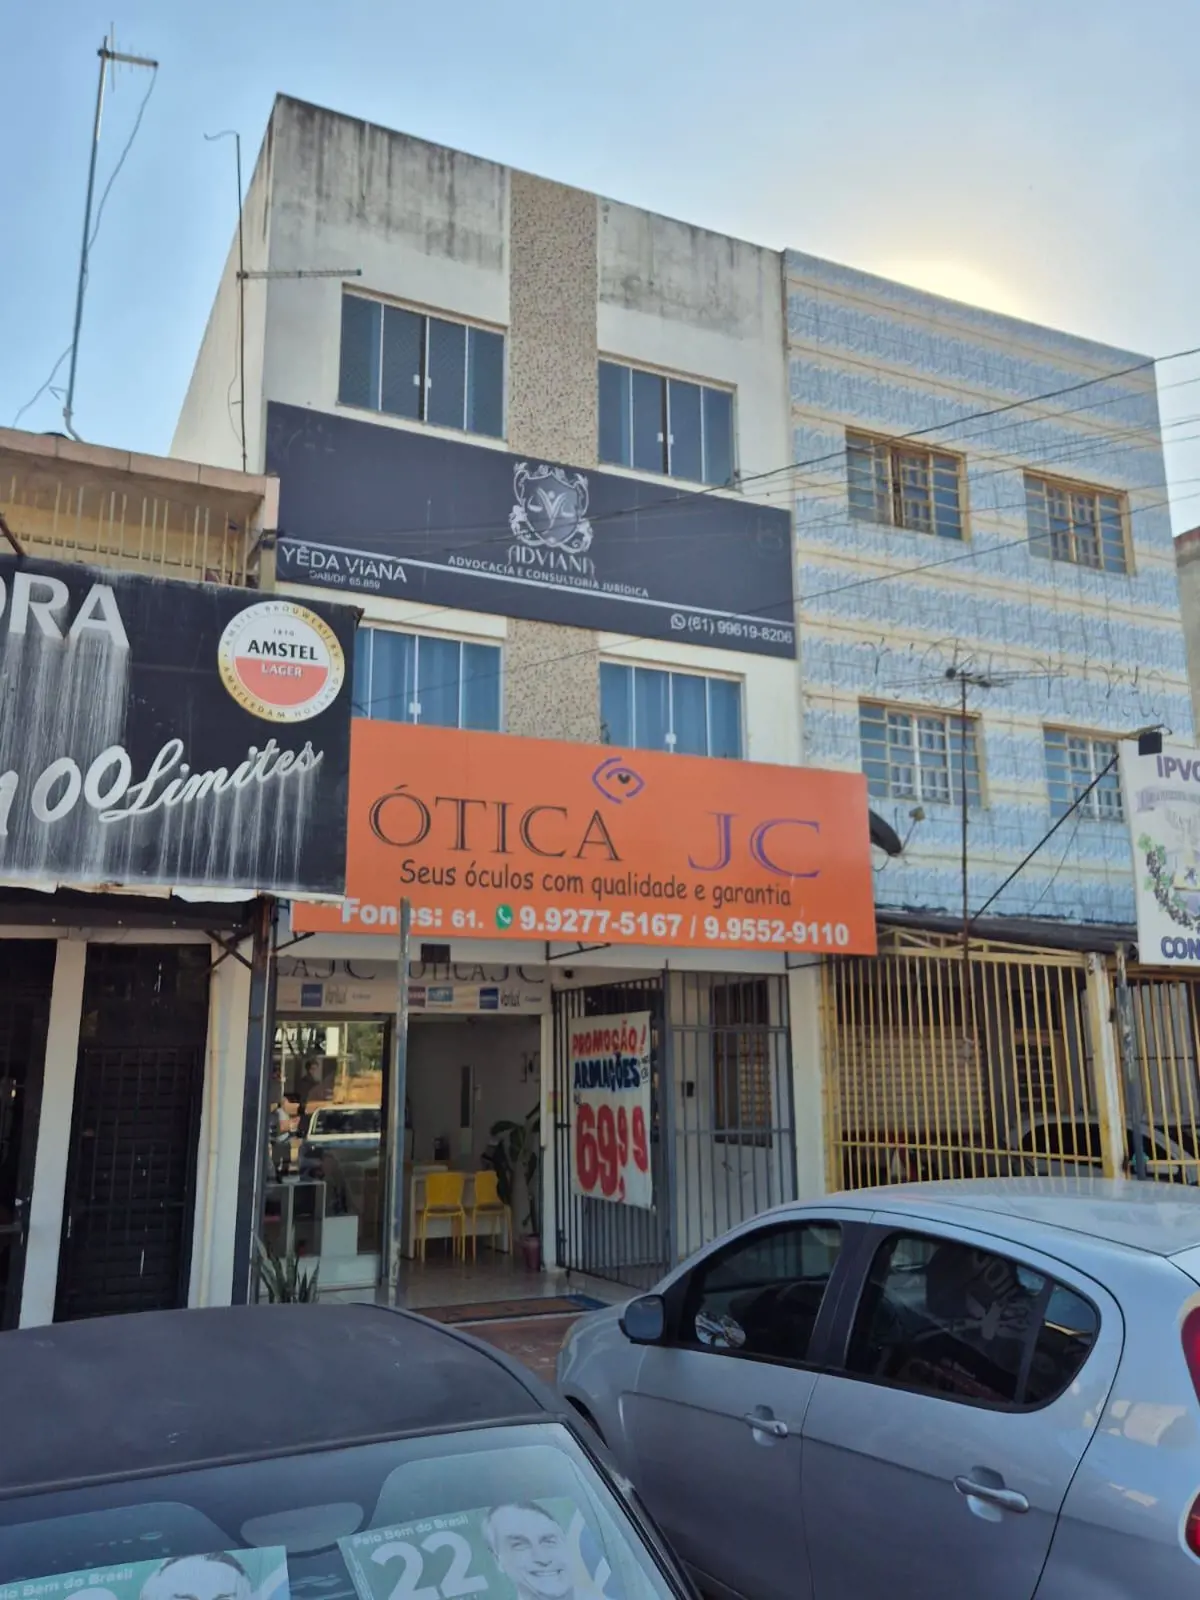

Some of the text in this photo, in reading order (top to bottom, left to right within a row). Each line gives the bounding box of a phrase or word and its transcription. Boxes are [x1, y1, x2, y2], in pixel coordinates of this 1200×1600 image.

[281, 545, 408, 584] YÊDA VIANA
[448, 555, 650, 598] ADVOCACIA E CONSULTORIA JURÍDICA
[0, 571, 131, 647] RA
[246, 640, 319, 661] AMSTEL
[261, 663, 303, 679] LAGER
[98, 737, 324, 823] Limites
[368, 784, 821, 879] ÓTICA JC
[400, 858, 792, 910] Seus óculos com qualidade e garantia
[451, 908, 485, 929] 61.
[518, 904, 682, 938] 9.9277-5167
[704, 914, 850, 946] 9.9552-9110
[88, 1567, 134, 1586] Brasil
[371, 1530, 490, 1600] 22
